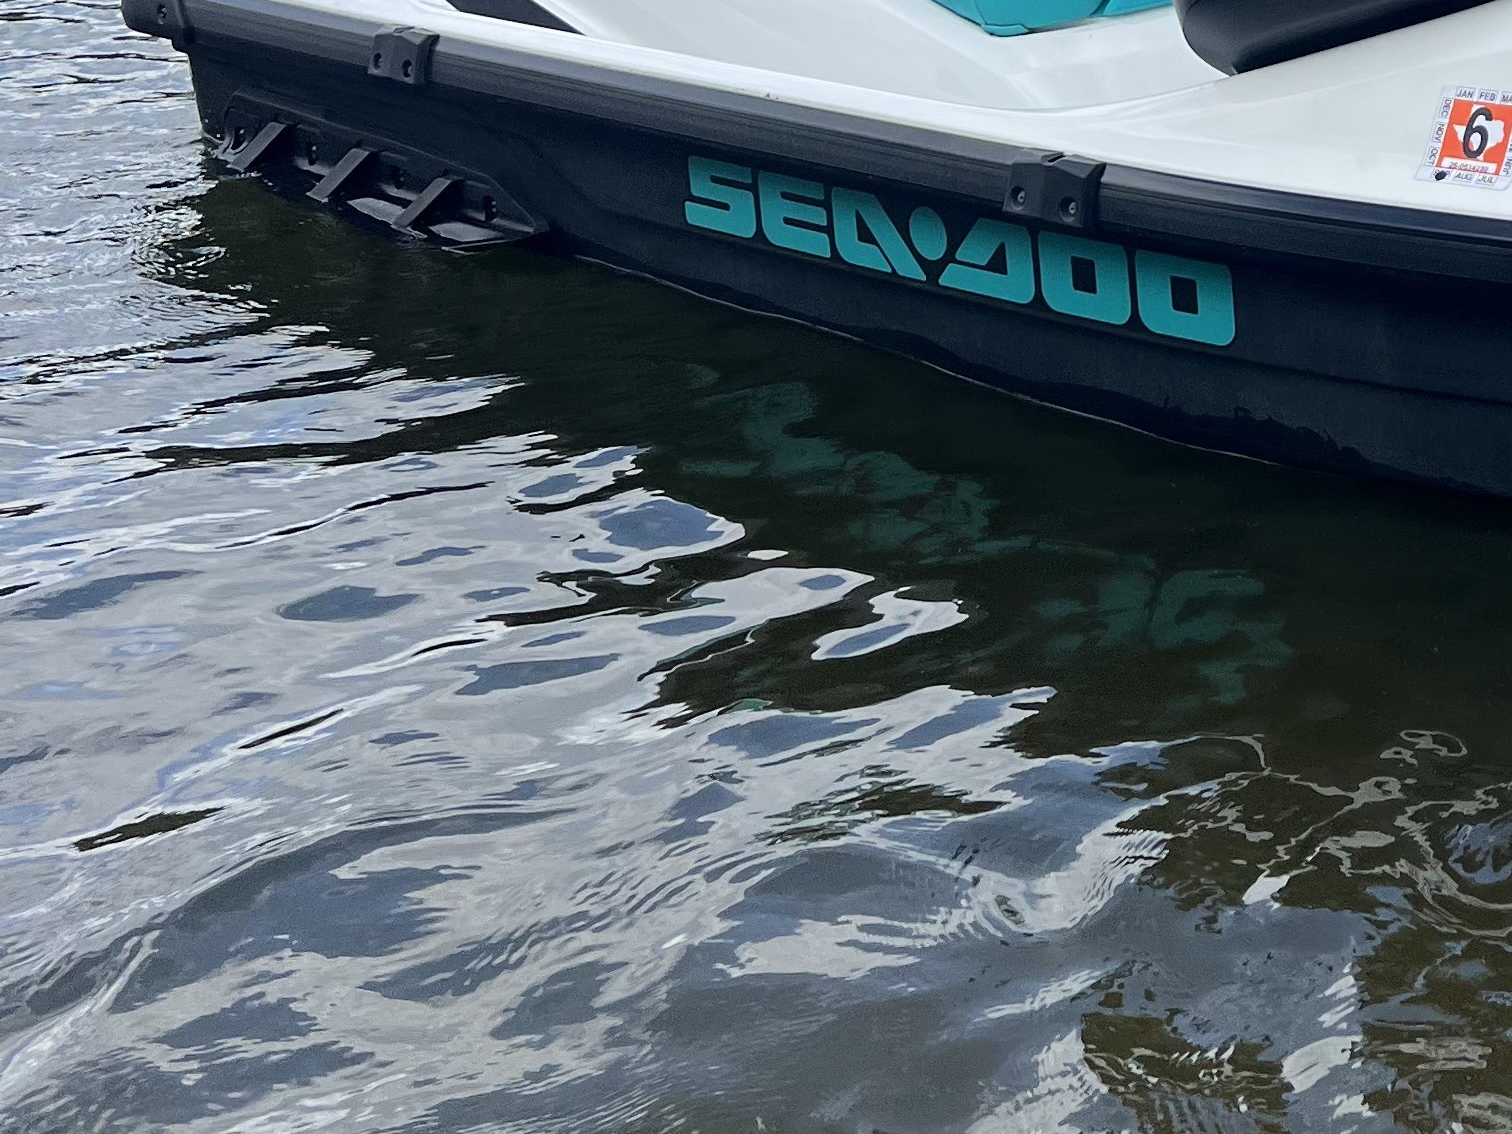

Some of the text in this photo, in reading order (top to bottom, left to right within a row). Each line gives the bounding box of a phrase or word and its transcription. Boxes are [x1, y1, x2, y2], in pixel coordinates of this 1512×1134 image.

[1456, 88, 1475, 99] JAN
[1427, 99, 1452, 167] DEC NOV OCT
[1463, 107, 1493, 159] 6
[1455, 172, 1473, 181] AUG
